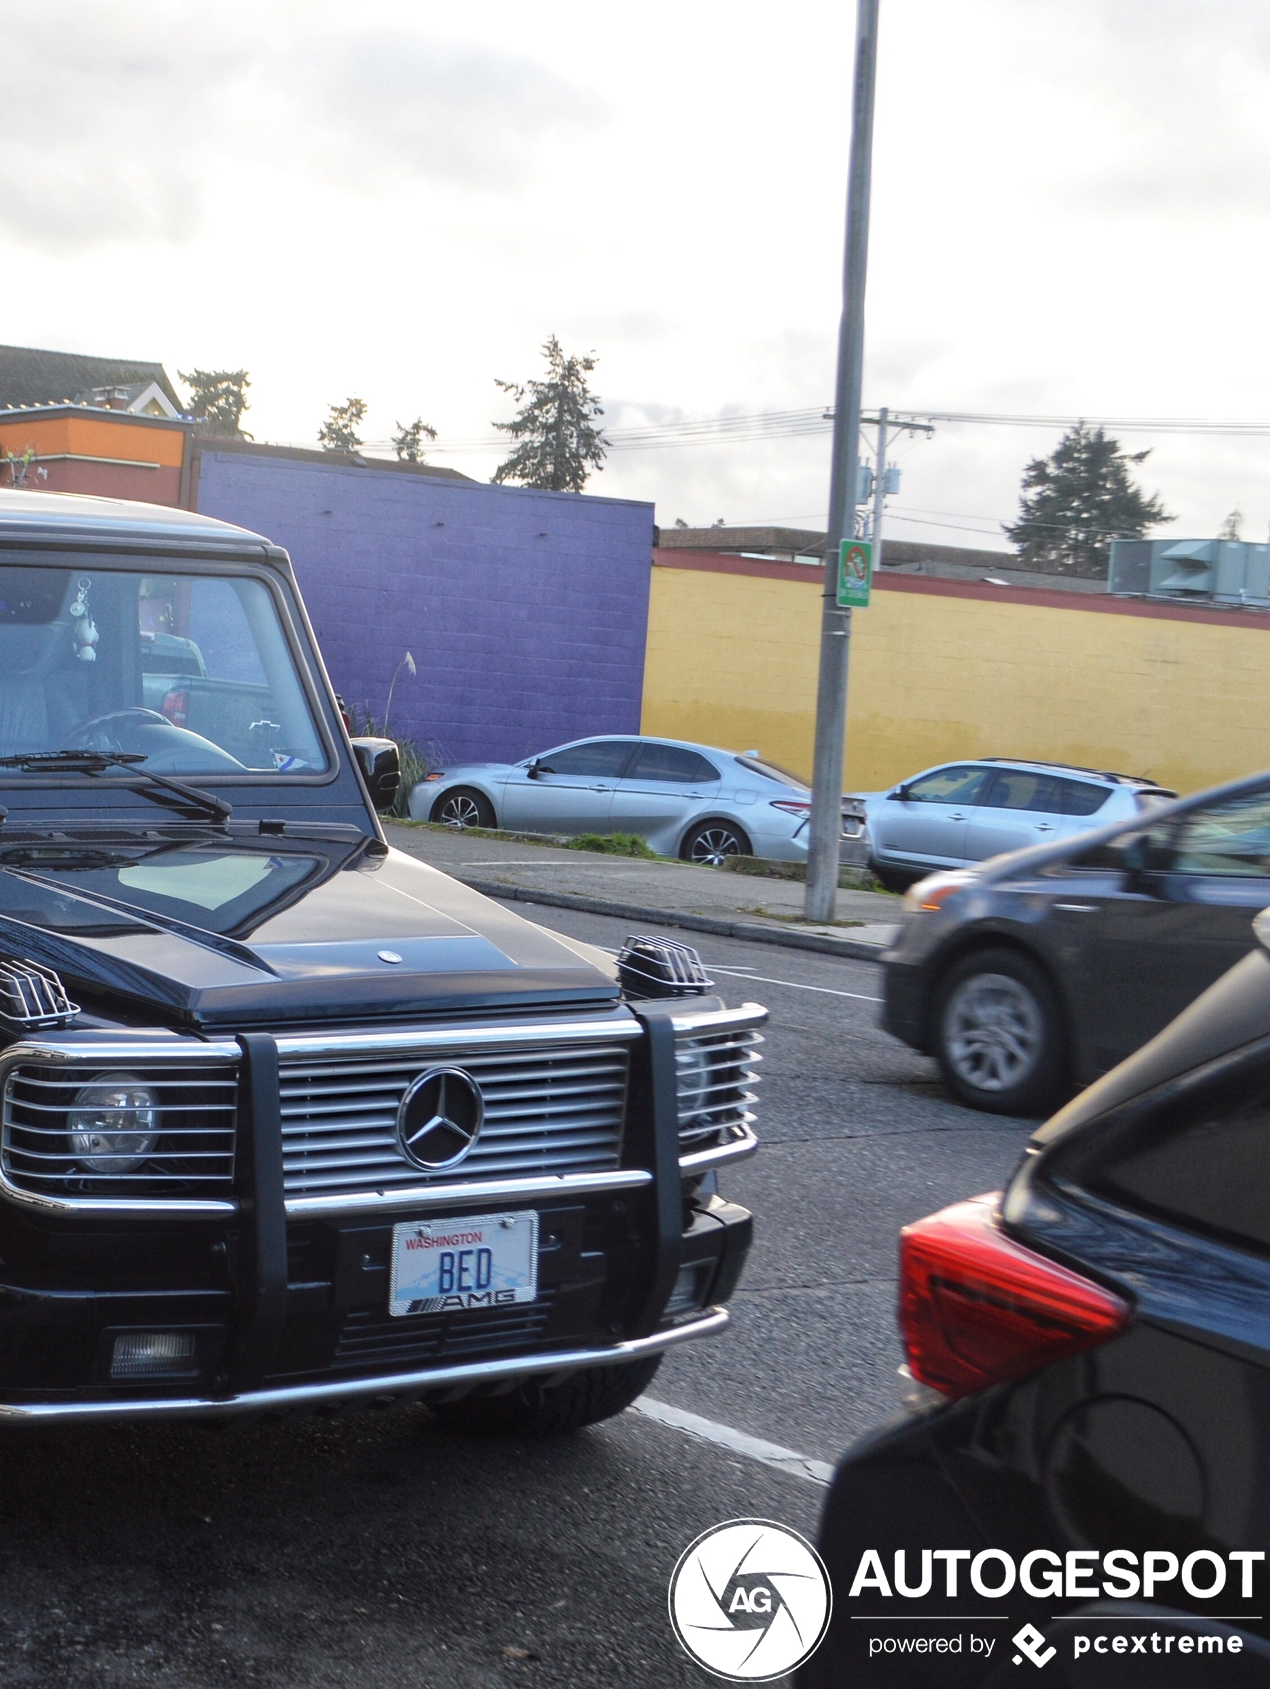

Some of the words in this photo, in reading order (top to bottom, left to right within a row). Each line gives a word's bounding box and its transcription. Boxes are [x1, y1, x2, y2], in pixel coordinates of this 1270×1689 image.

[405, 1231, 483, 1251] WASHINGTON
[438, 1247, 492, 1294] BED
[440, 1288, 517, 1310] AMG
